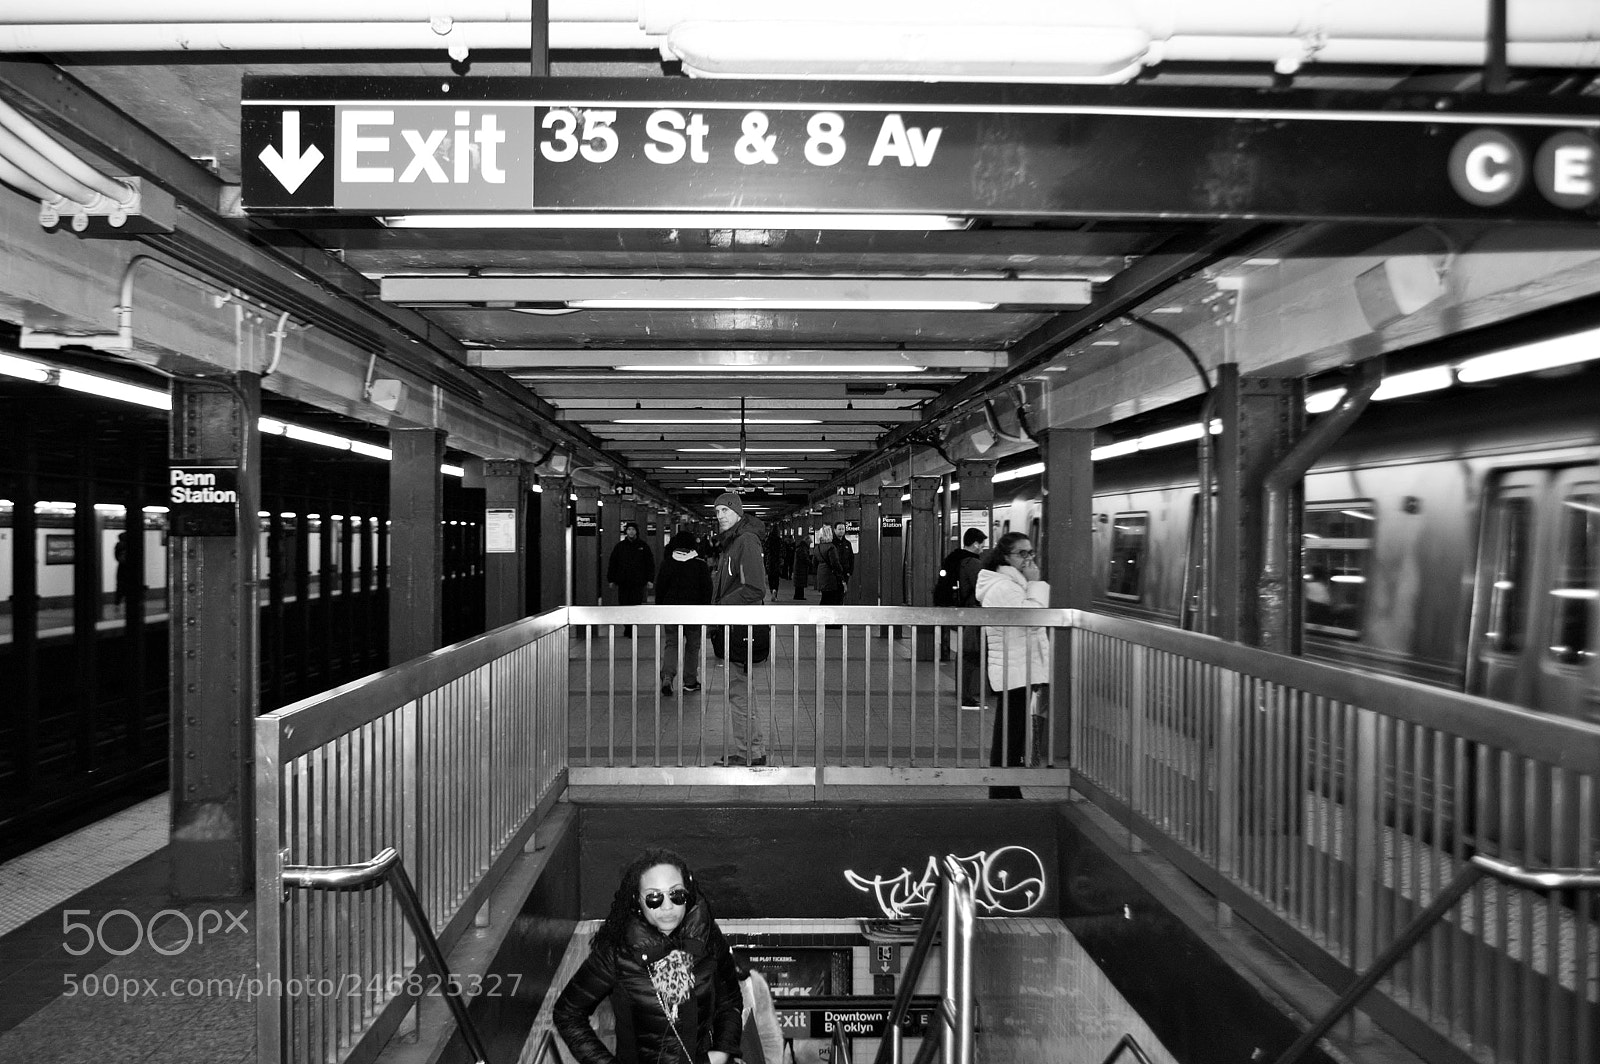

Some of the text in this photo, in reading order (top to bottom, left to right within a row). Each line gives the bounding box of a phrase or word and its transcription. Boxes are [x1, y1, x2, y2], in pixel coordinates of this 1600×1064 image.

[340, 109, 943, 184] Exit 35 St & 8 Av
[1465, 142, 1593, 195] C E
[170, 469, 216, 486] Penn
[170, 486, 236, 504] Station
[824, 1011, 883, 1021] Downtown
[920, 1014, 928, 1024] E
[824, 1022, 874, 1034] Broklyn
[818, 1047, 831, 1056] pri
